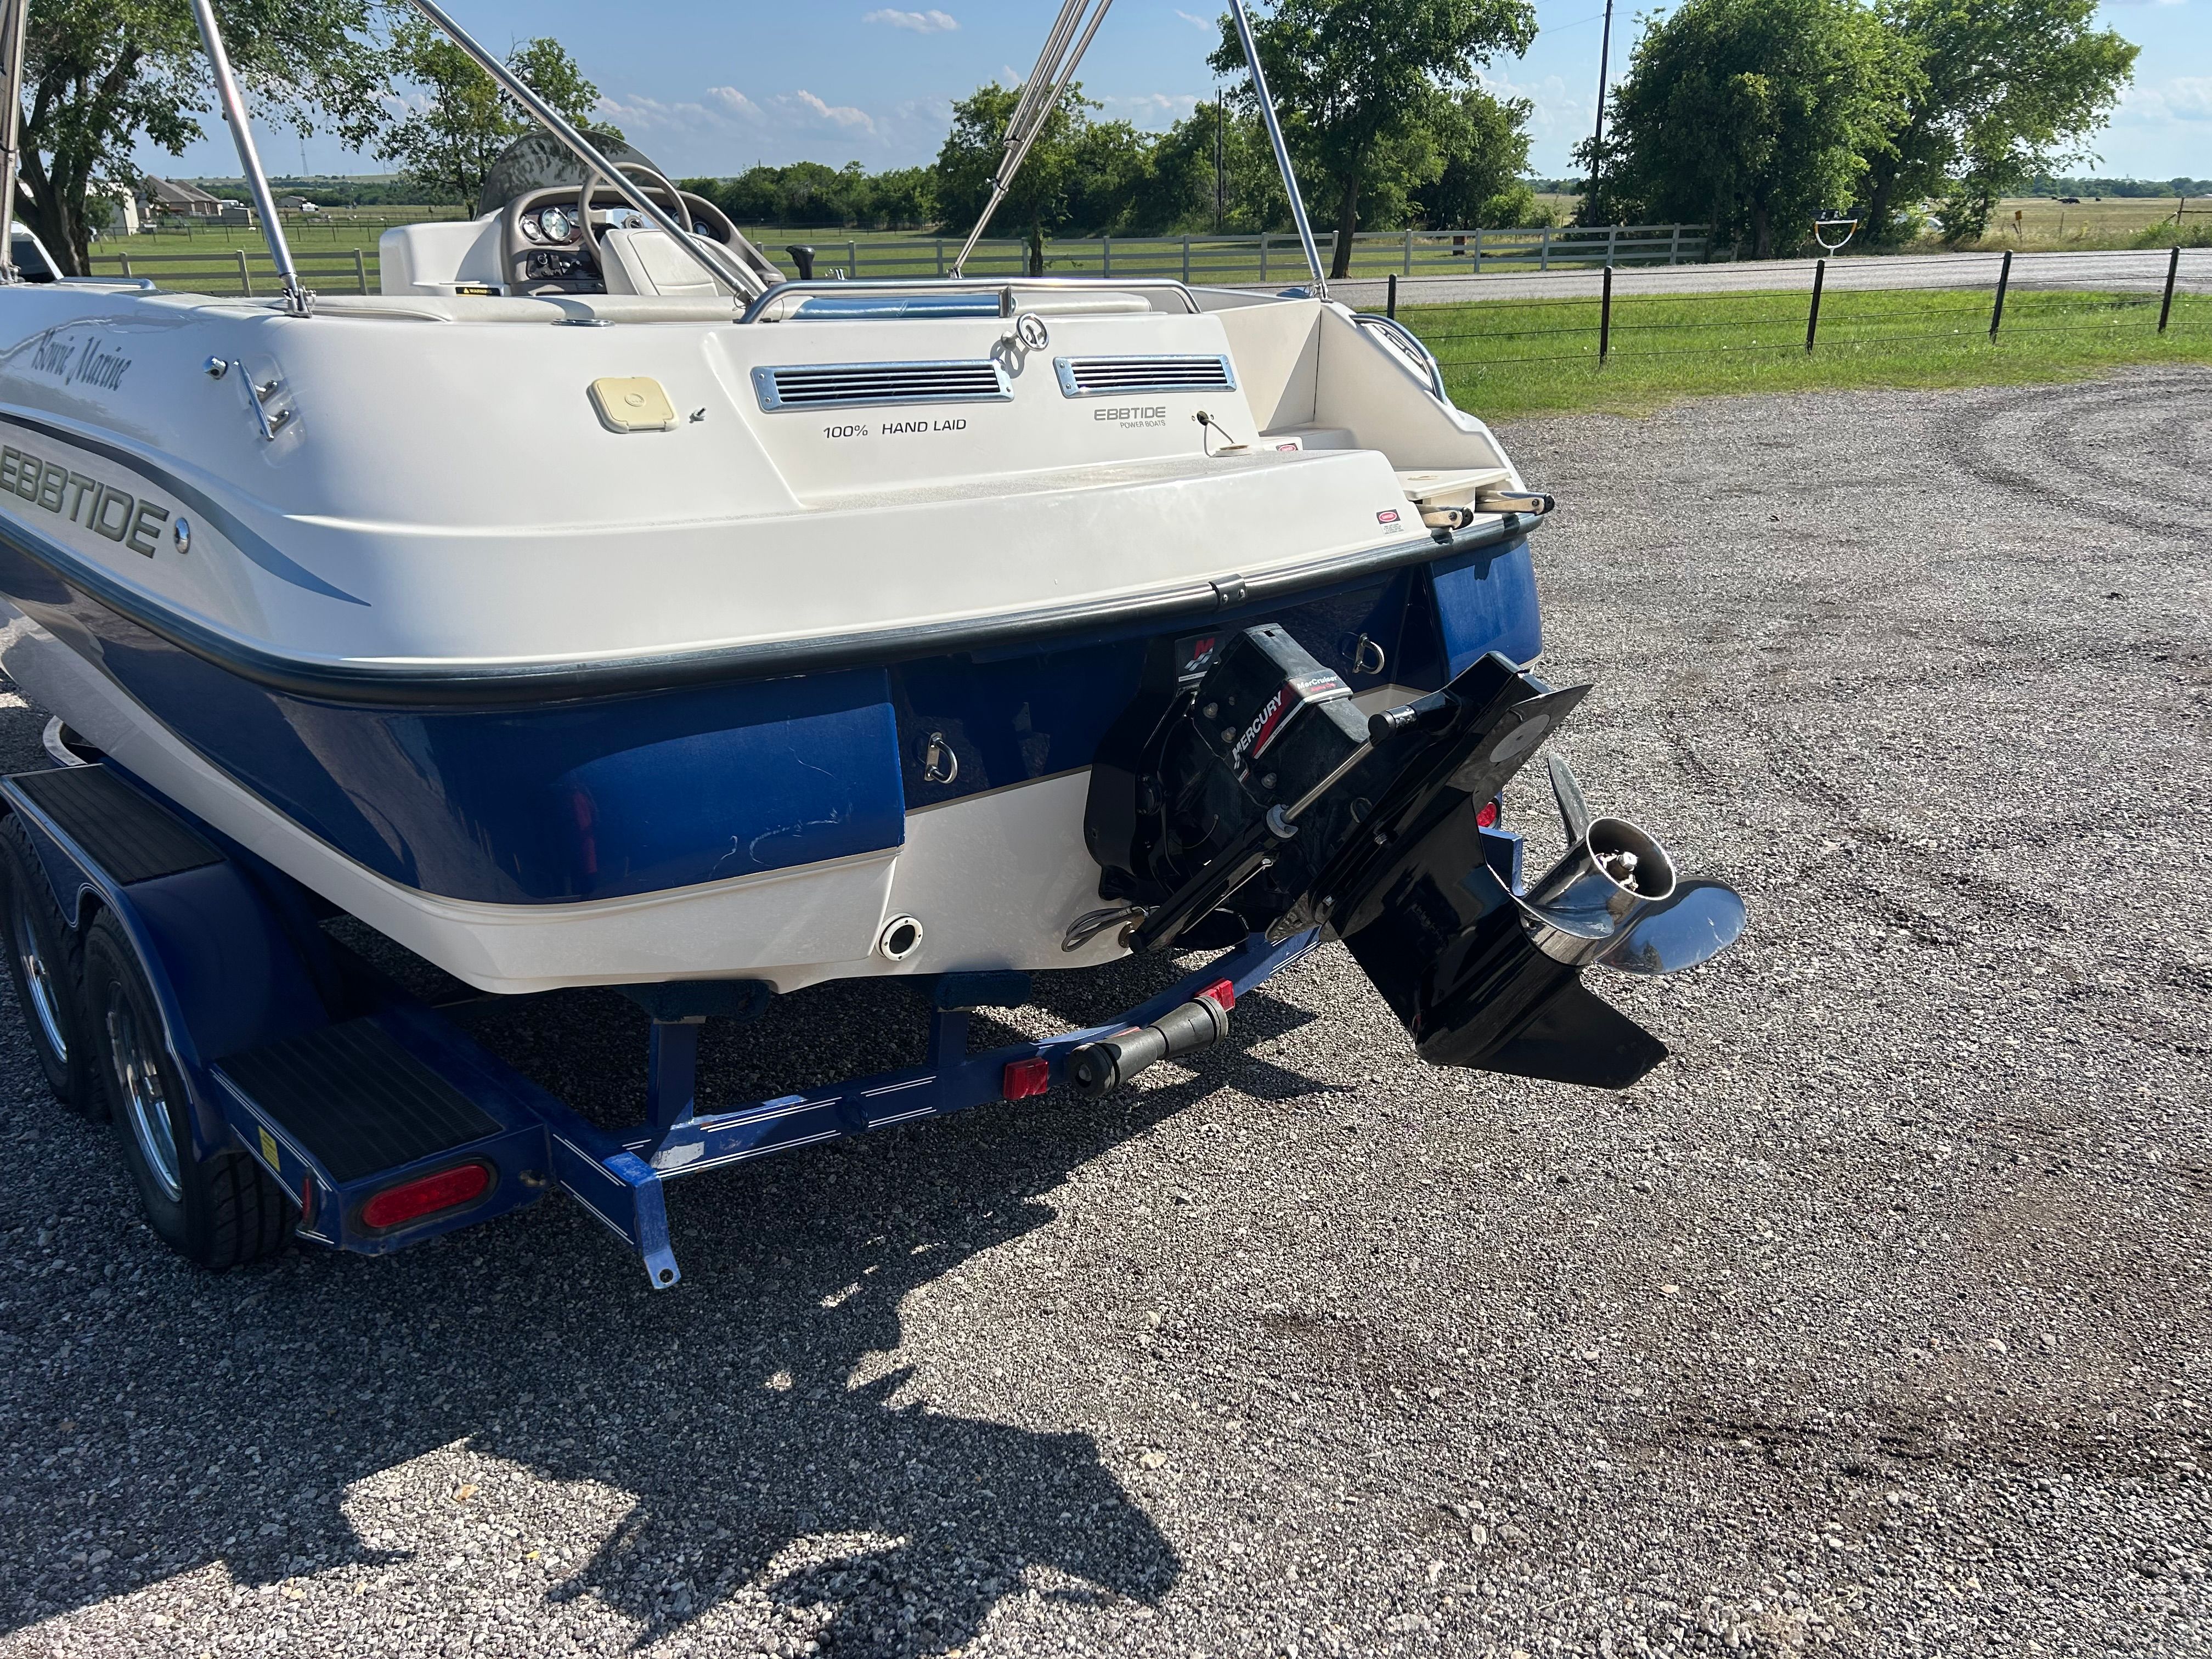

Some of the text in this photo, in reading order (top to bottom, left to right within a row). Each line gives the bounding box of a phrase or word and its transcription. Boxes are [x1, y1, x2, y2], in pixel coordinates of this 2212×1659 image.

[64, 336, 132, 392] Marine
[823, 419, 967, 438] 100% HAND LAID
[1094, 406, 1166, 421] EBBTIDE
[0, 444, 170, 559] EBBTIDE
[1296, 675, 1338, 690] MerCruiser
[1232, 690, 1283, 763] MERCURY
